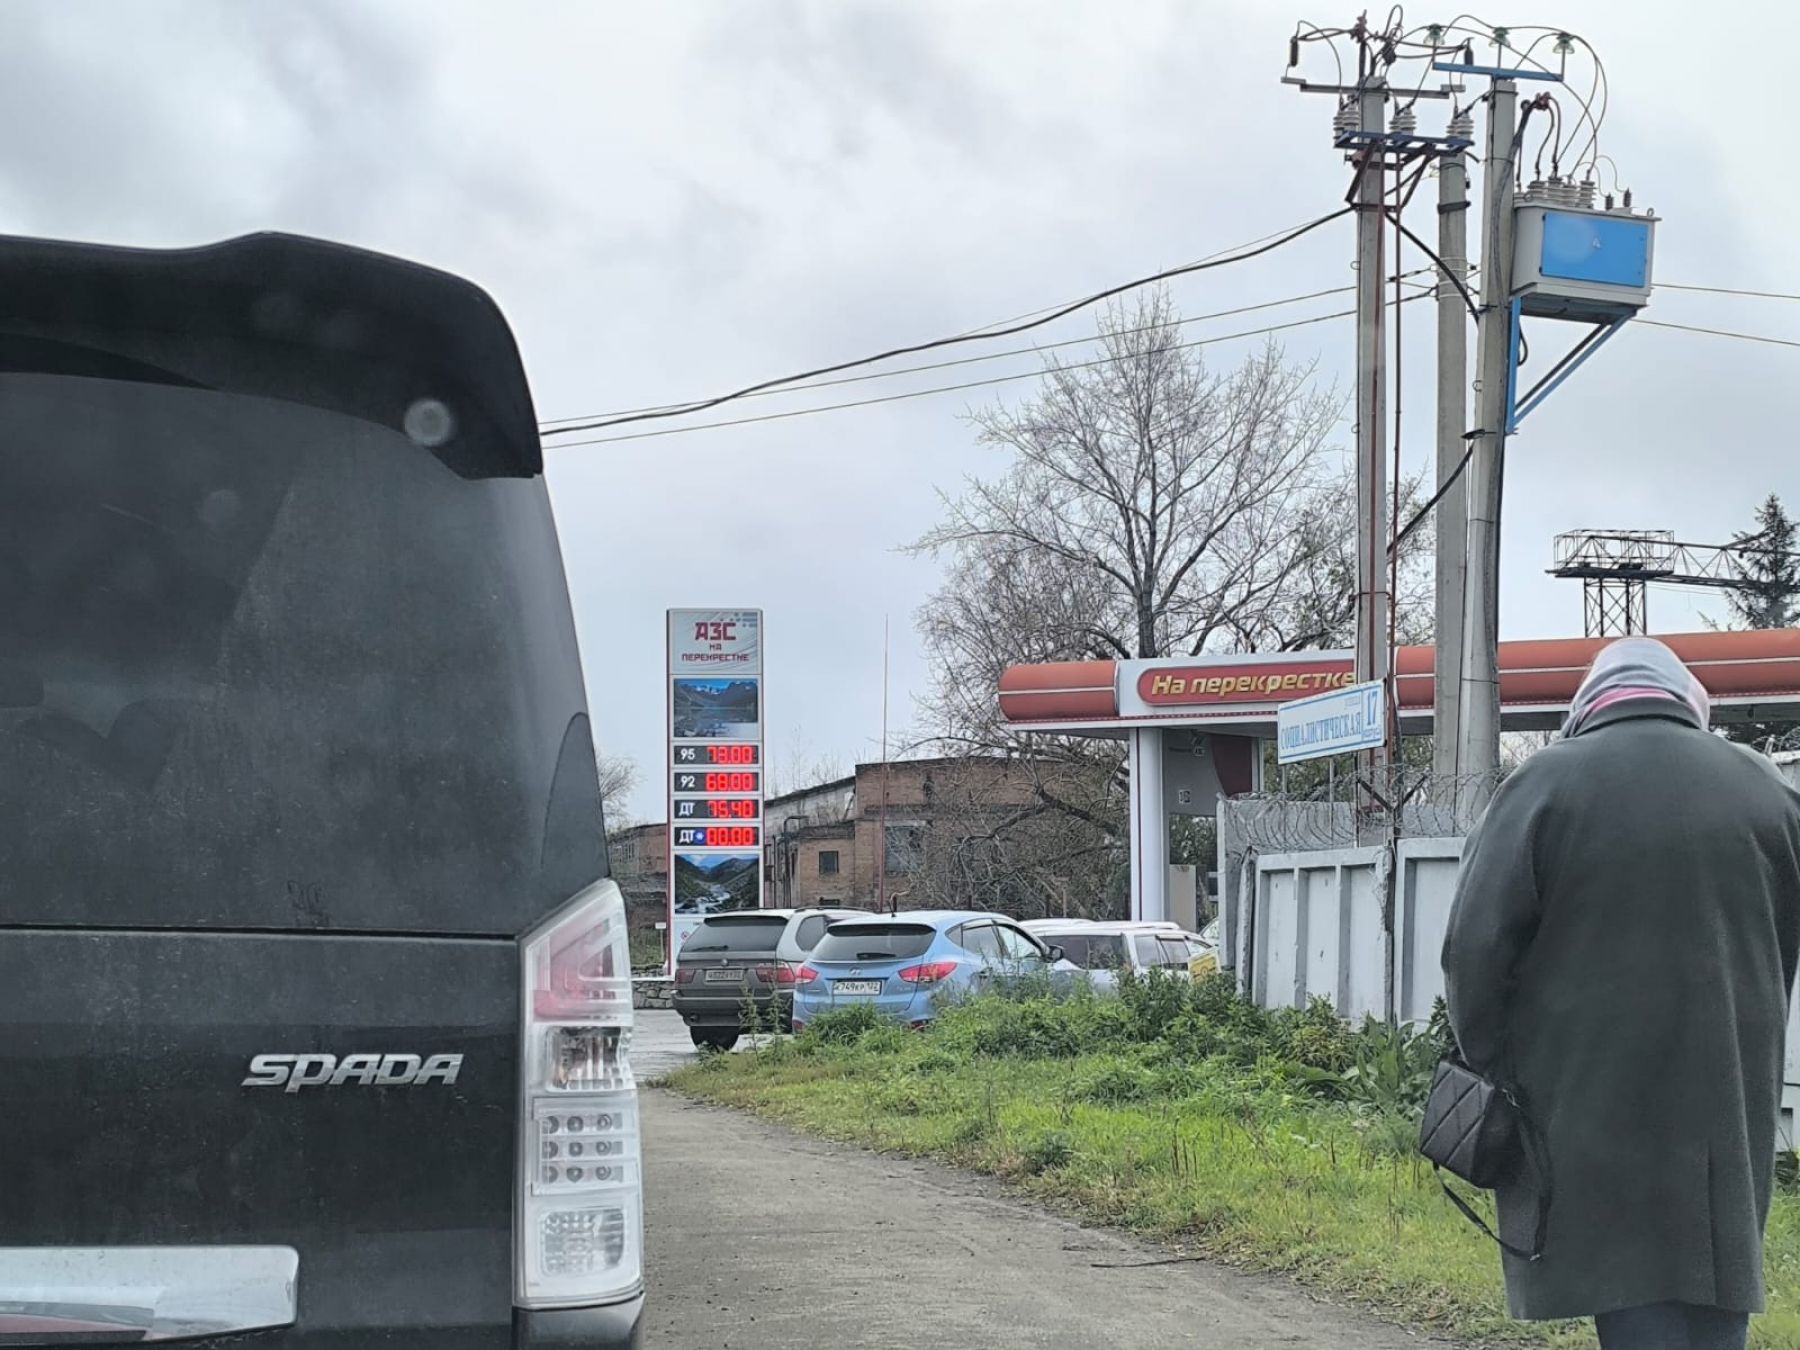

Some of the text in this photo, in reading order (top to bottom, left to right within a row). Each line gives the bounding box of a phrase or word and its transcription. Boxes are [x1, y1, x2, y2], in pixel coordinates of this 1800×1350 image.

[694, 621, 737, 641] АЗС
[1151, 671, 1356, 697] На перекрестке
[1367, 690, 1378, 726] 17
[680, 748, 696, 760] 95
[680, 775, 696, 788] 92
[679, 802, 696, 816] ДТ
[679, 829, 696, 844] ДТ
[240, 1053, 465, 1093] SPADA
